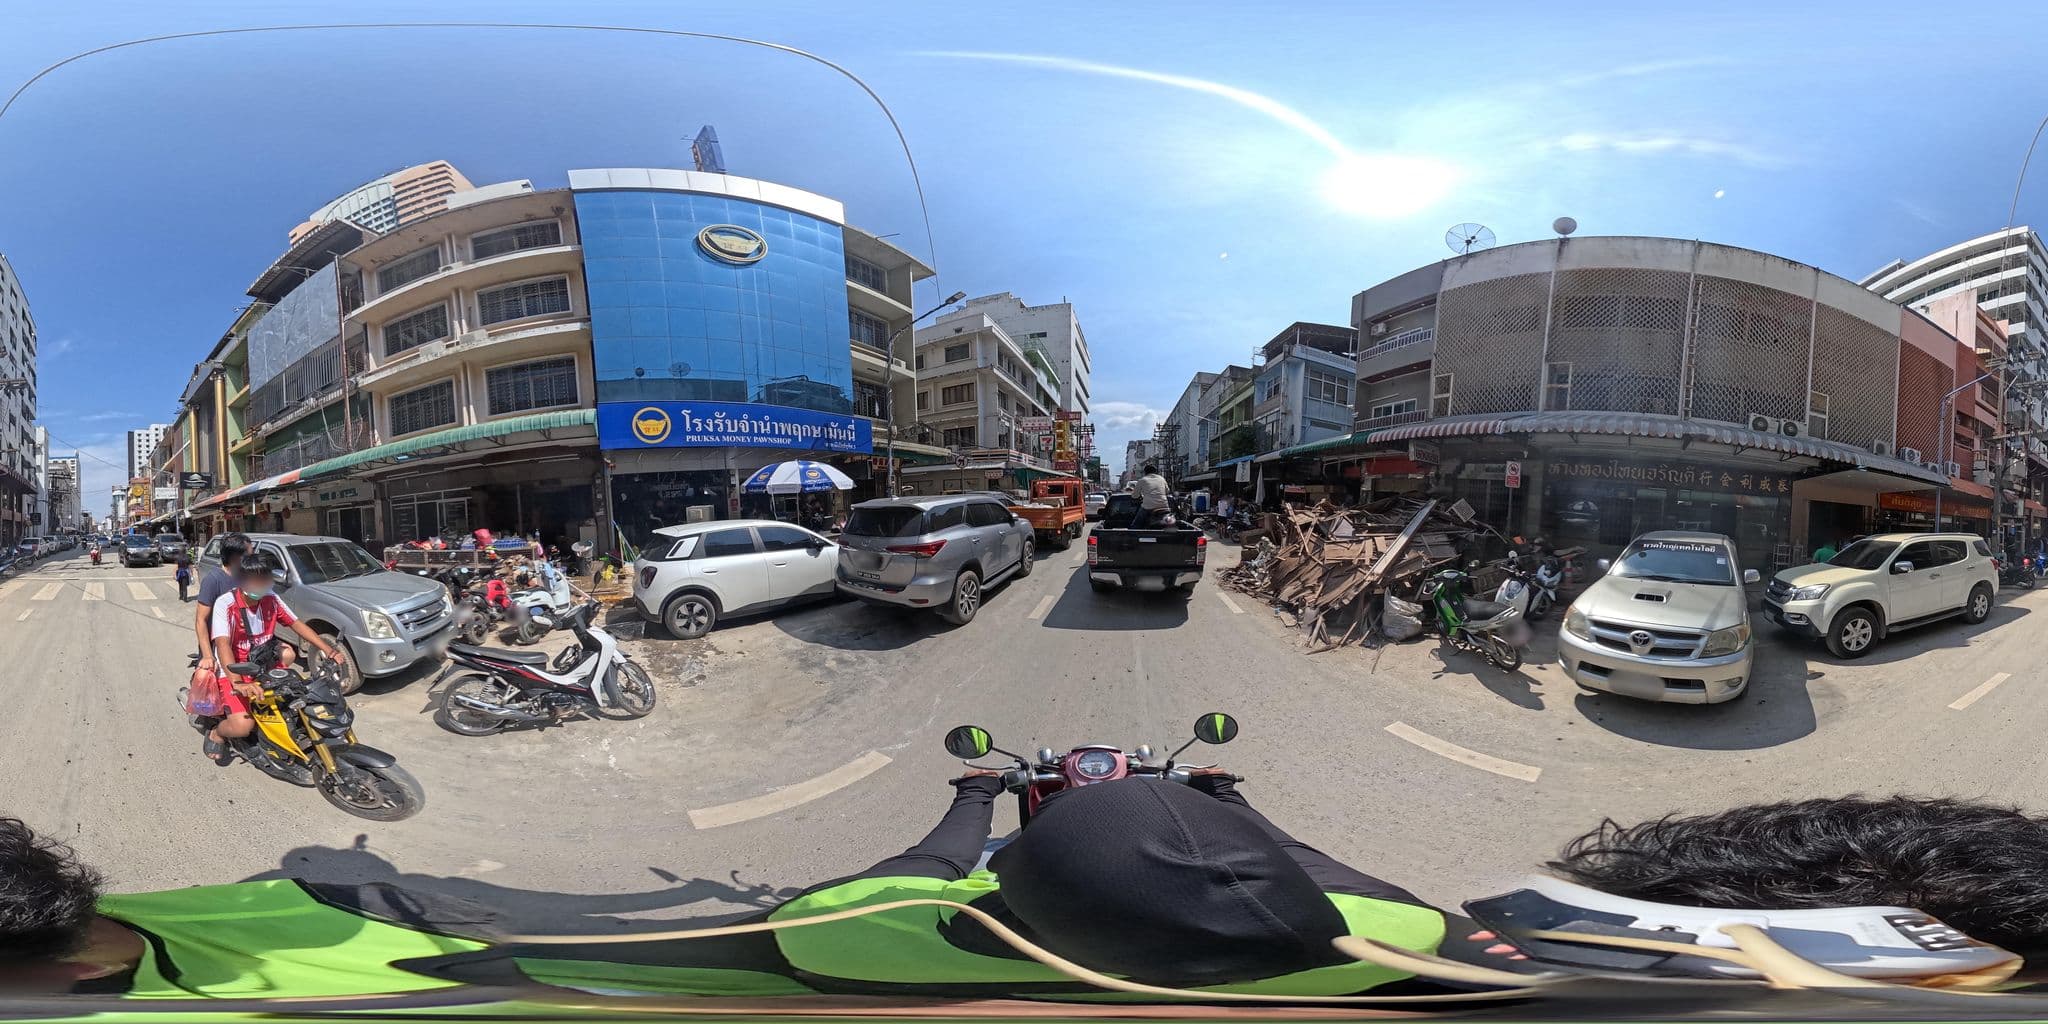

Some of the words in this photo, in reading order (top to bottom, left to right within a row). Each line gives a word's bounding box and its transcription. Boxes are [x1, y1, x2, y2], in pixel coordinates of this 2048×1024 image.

[681, 409, 856, 442] โรงรับจำนำพฤกษามันนี่
[686, 435, 720, 443] PRUKSA
[722, 435, 751, 443] MONEY
[753, 436, 792, 445] PAWNSHOP
